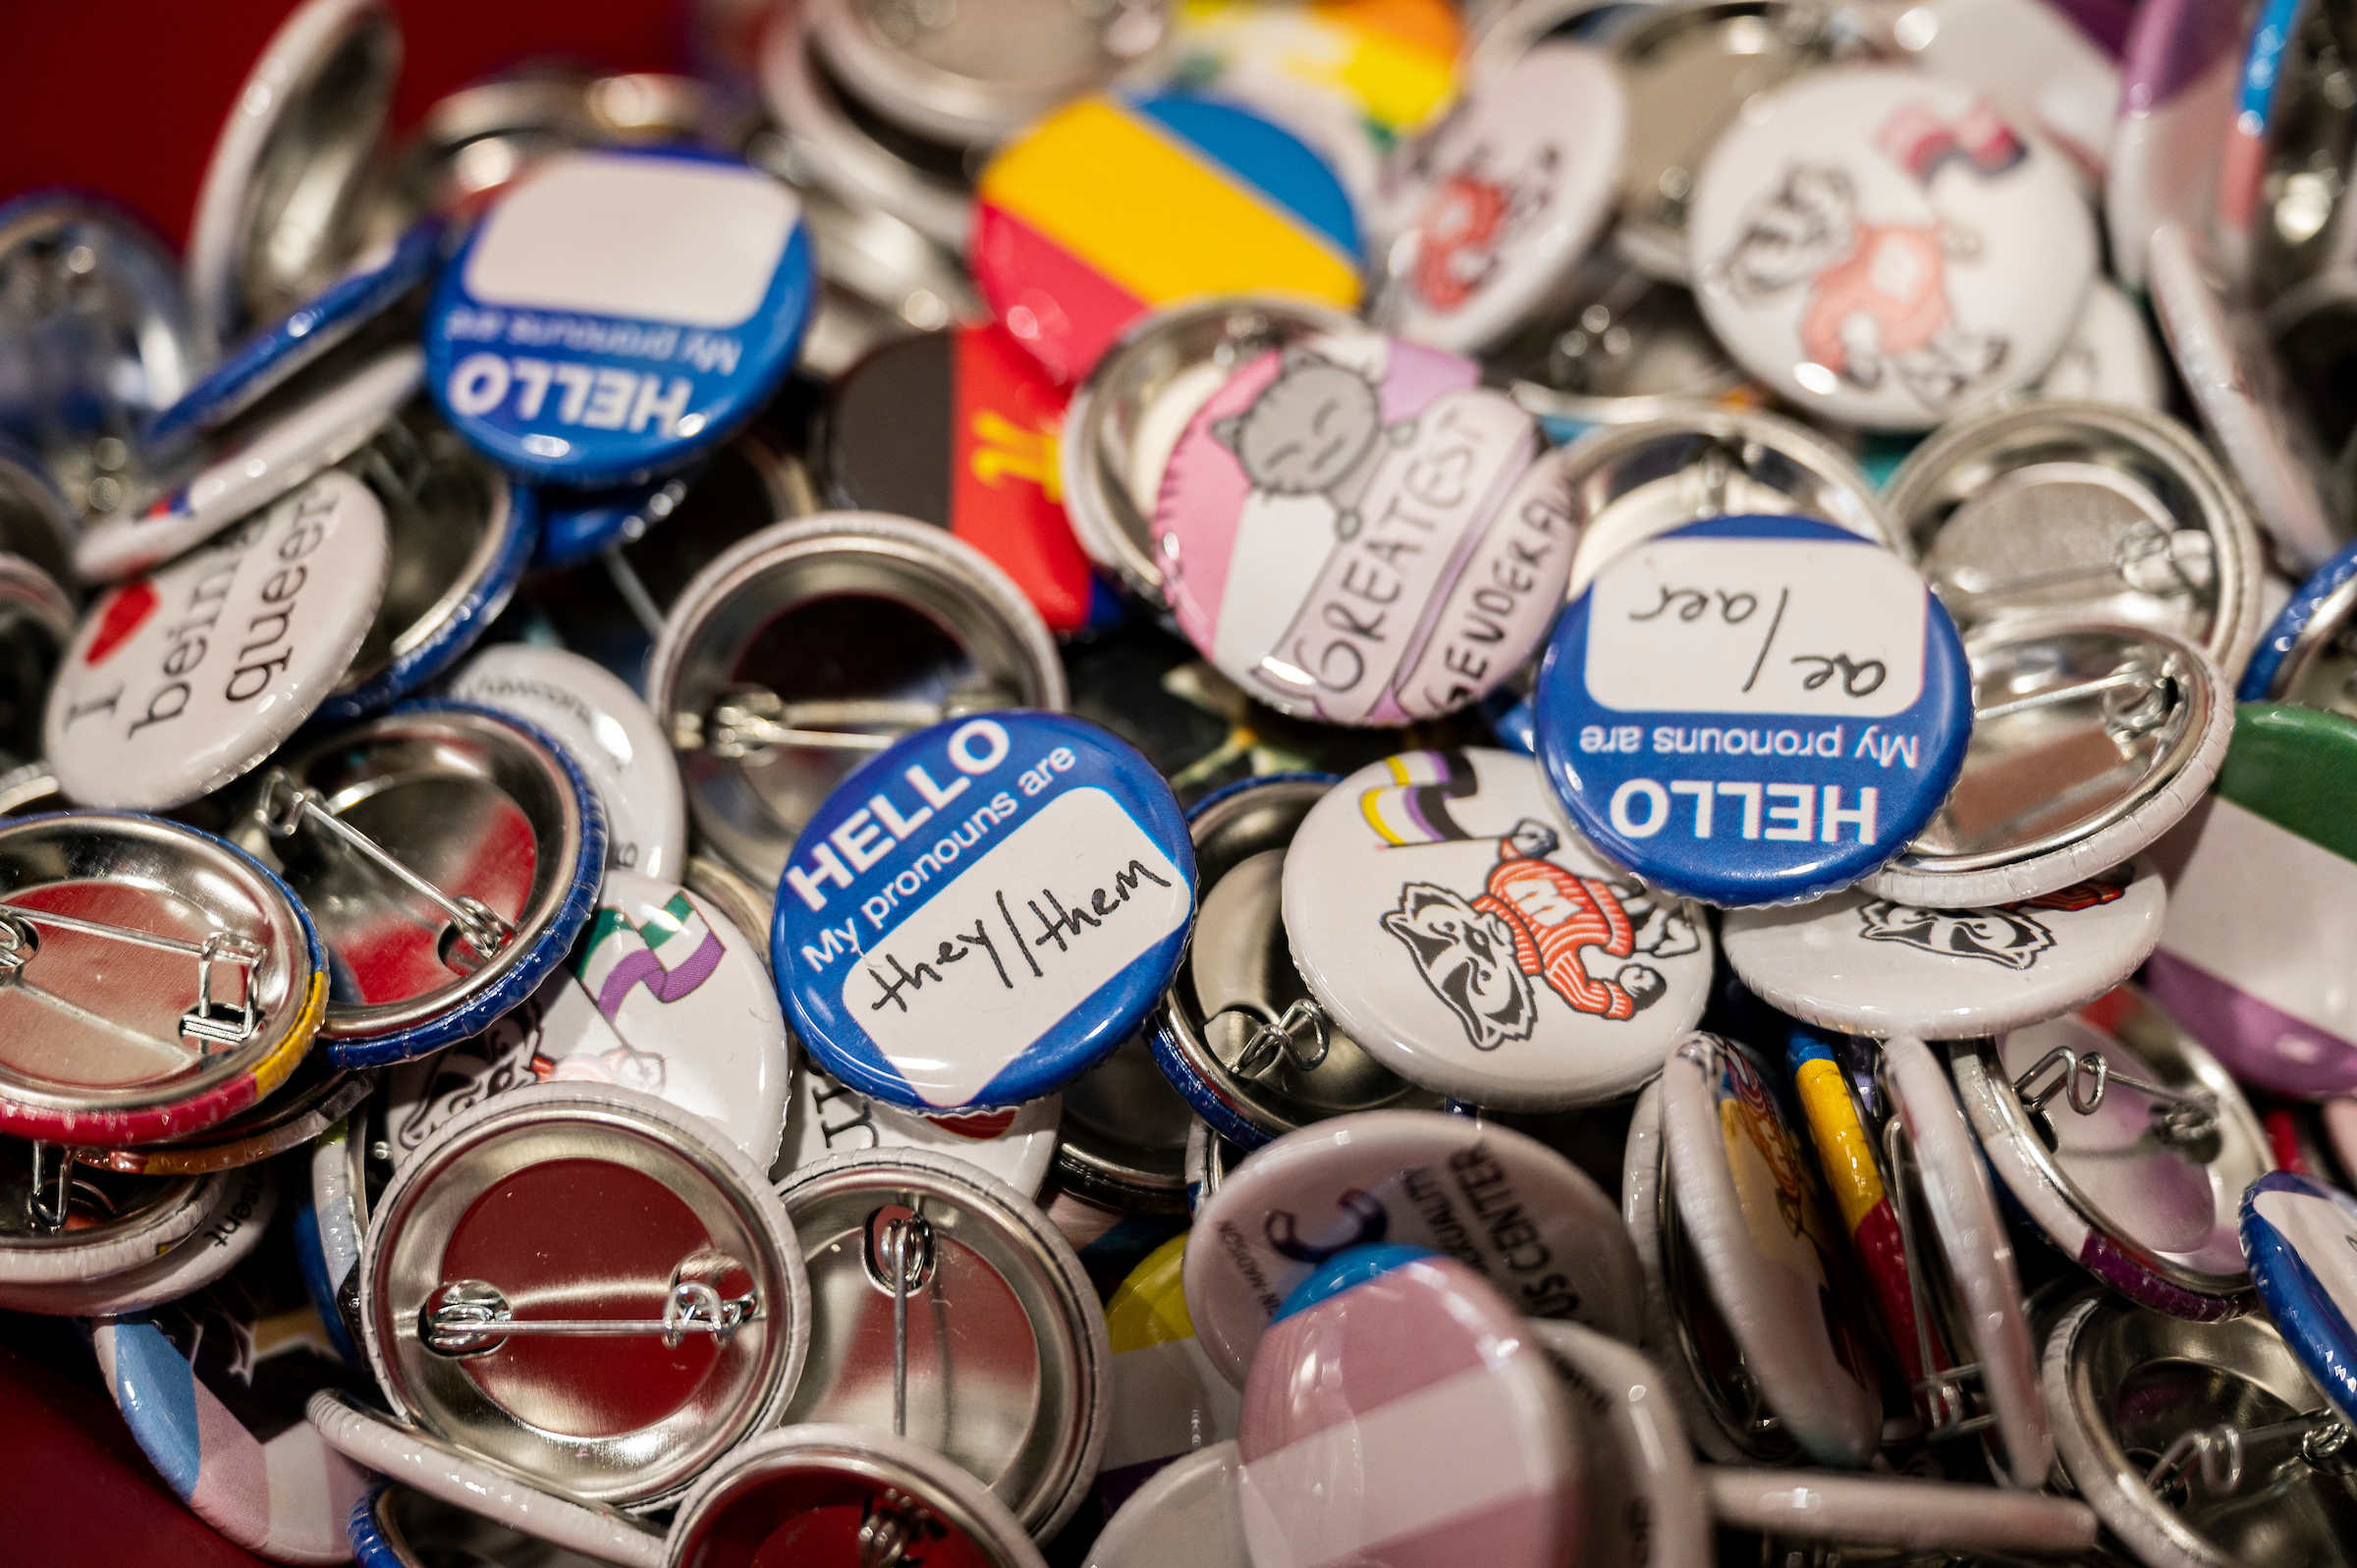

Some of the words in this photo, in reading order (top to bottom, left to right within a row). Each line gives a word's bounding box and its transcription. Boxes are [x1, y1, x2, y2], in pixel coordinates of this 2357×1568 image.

[447, 351, 693, 437] HELLO
[225, 490, 343, 702] queer
[1293, 405, 1487, 692] GREATEST
[63, 684, 126, 733] I
[1578, 725, 1645, 754] are
[1652, 724, 1843, 758] pronouns
[1854, 726, 1920, 769] My
[786, 718, 1011, 913] HELLO
[800, 917, 859, 973] My
[859, 789, 1019, 931] pronouns
[1016, 744, 1077, 797] are
[1609, 778, 1879, 846] HELLO
[866, 859, 1173, 1012] they/them
[1402, 1166, 1493, 1280] EXUALITY
[1450, 1140, 1551, 1271] CENTER
